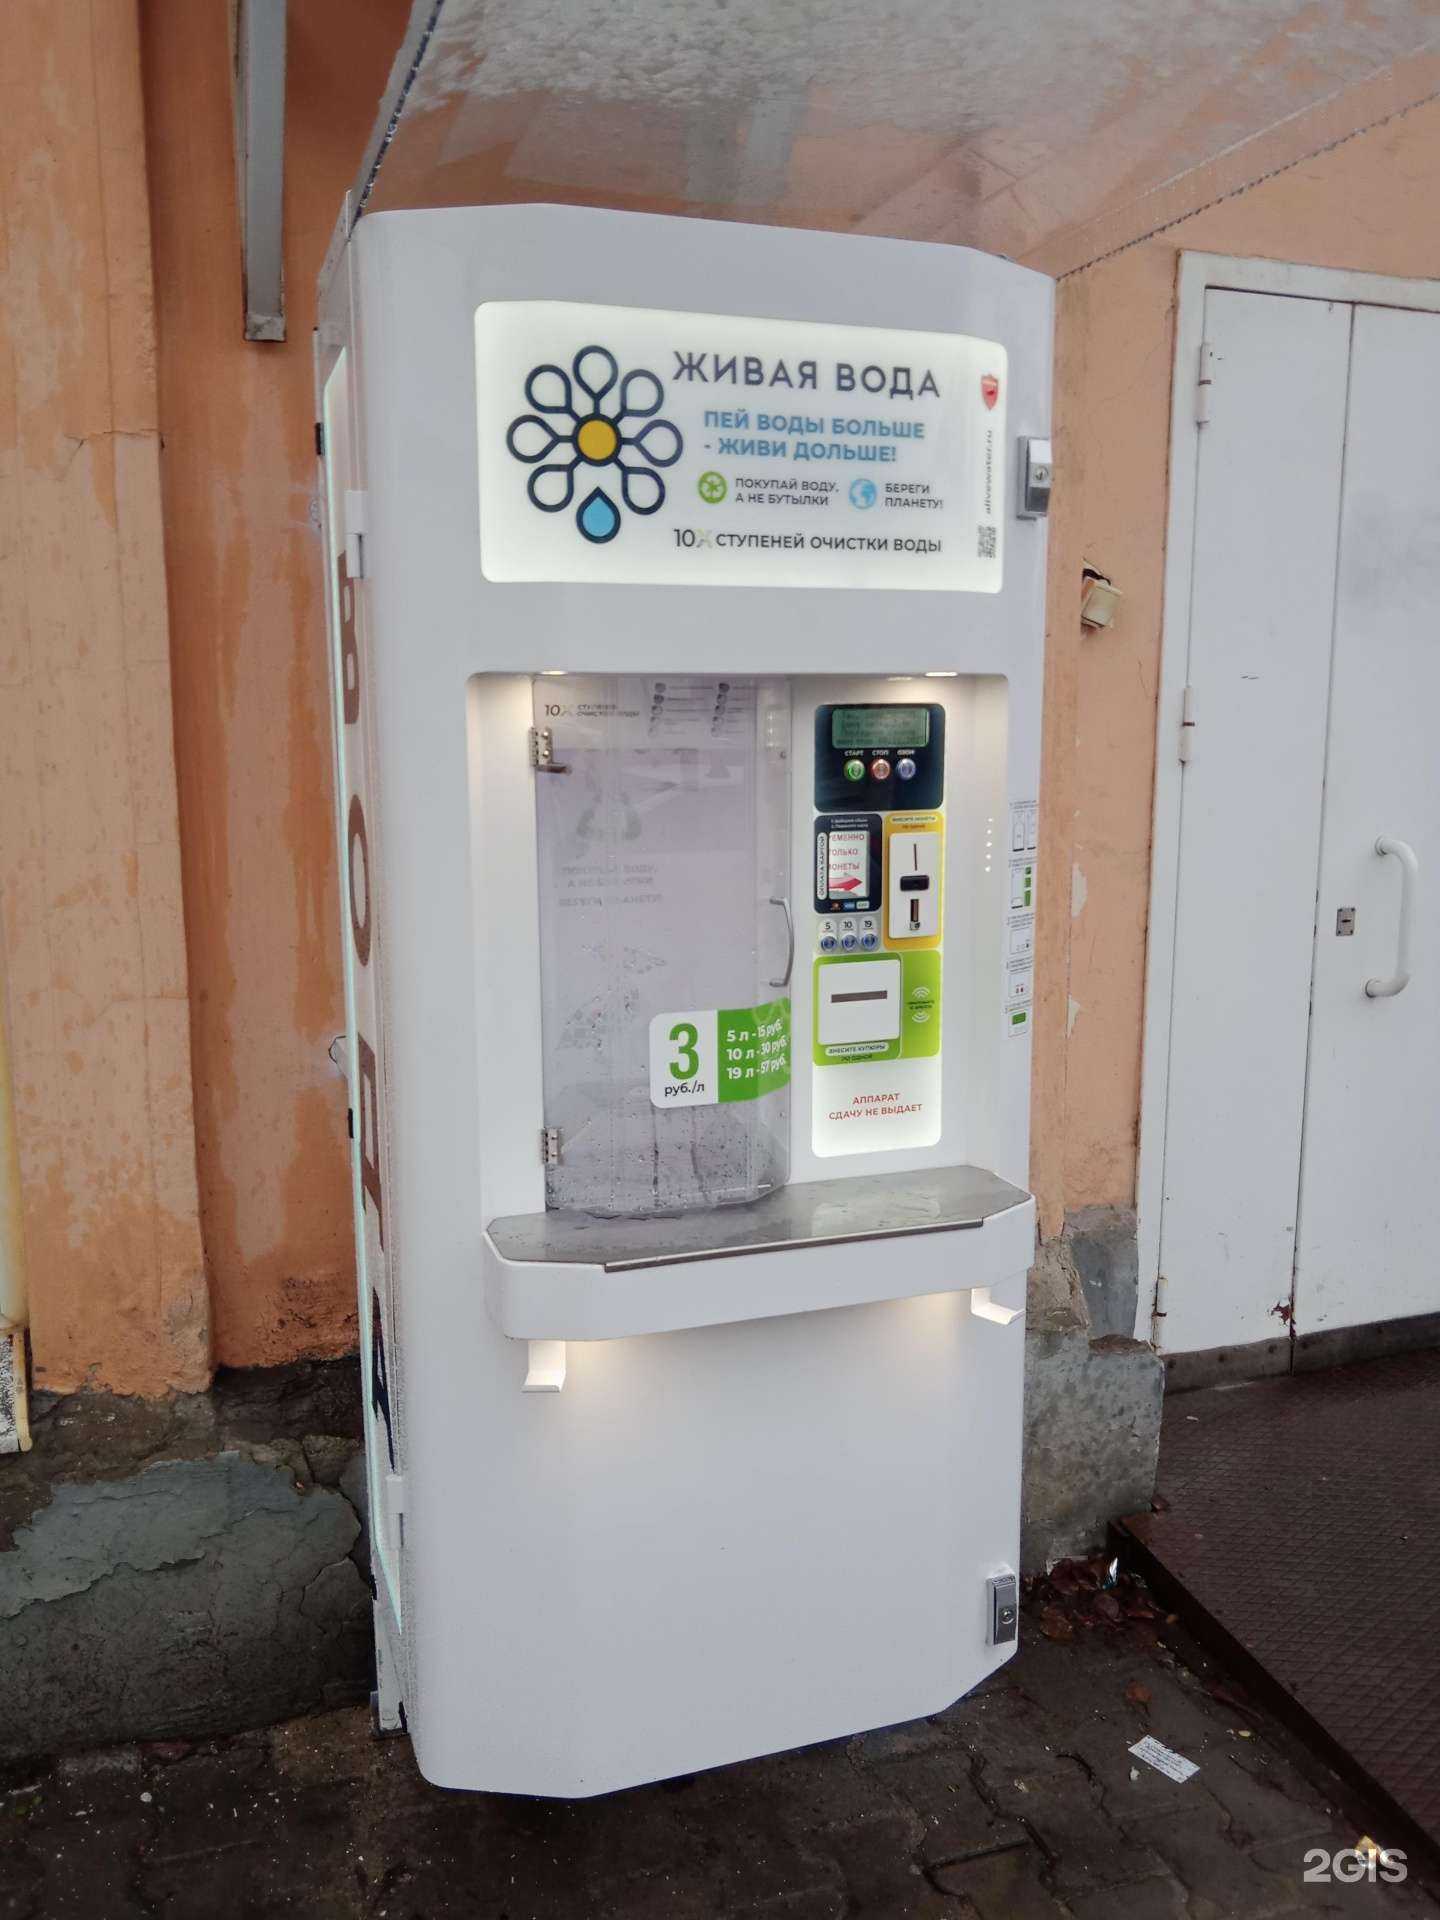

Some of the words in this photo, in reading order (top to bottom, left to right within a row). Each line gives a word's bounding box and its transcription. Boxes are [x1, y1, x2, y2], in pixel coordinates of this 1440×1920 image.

[673, 351, 818, 390] ЖИВАЯ
[835, 363, 940, 400] ВОДА
[704, 409, 749, 430] ПЕЙ
[757, 414, 824, 435] ВОДЫ
[832, 418, 925, 439] БОЛЬШЕ
[719, 437, 786, 458] ЖИВИ
[793, 443, 897, 463] ДОЛЬШЕ!
[735, 477, 798, 491] ПОКУПАЙ
[884, 483, 931, 494] БЕРЕГИ
[735, 493, 745, 503] А
[747, 494, 766, 504] НЕ
[767, 495, 830, 506] БУТЫЛКИ
[884, 498, 944, 510] ПЛАНЕТУ!
[716, 532, 805, 550] СТУПЕНЕЙ
[810, 536, 888, 551] ОЧИСТКИ
[894, 539, 942, 554] ВОДЫ
[825, 922, 831, 930] 5
[843, 921, 853, 929] 10
[863, 920, 873, 928] 19
[727, 1030, 736, 1042] 5
[739, 1030, 749, 1041] л
[669, 1023, 699, 1080] 3
[726, 1048, 742, 1060] 10
[745, 1049, 755, 1060] л
[726, 1067, 742, 1079] 19
[745, 1067, 755, 1078] л
[664, 1080, 705, 1097] руб./л
[853, 1092, 901, 1105] АППАРАТ
[828, 1110, 862, 1121] СДАЧУ
[865, 1107, 879, 1117] НЕ
[881, 1103, 923, 1115] ВЫДАЕТ
